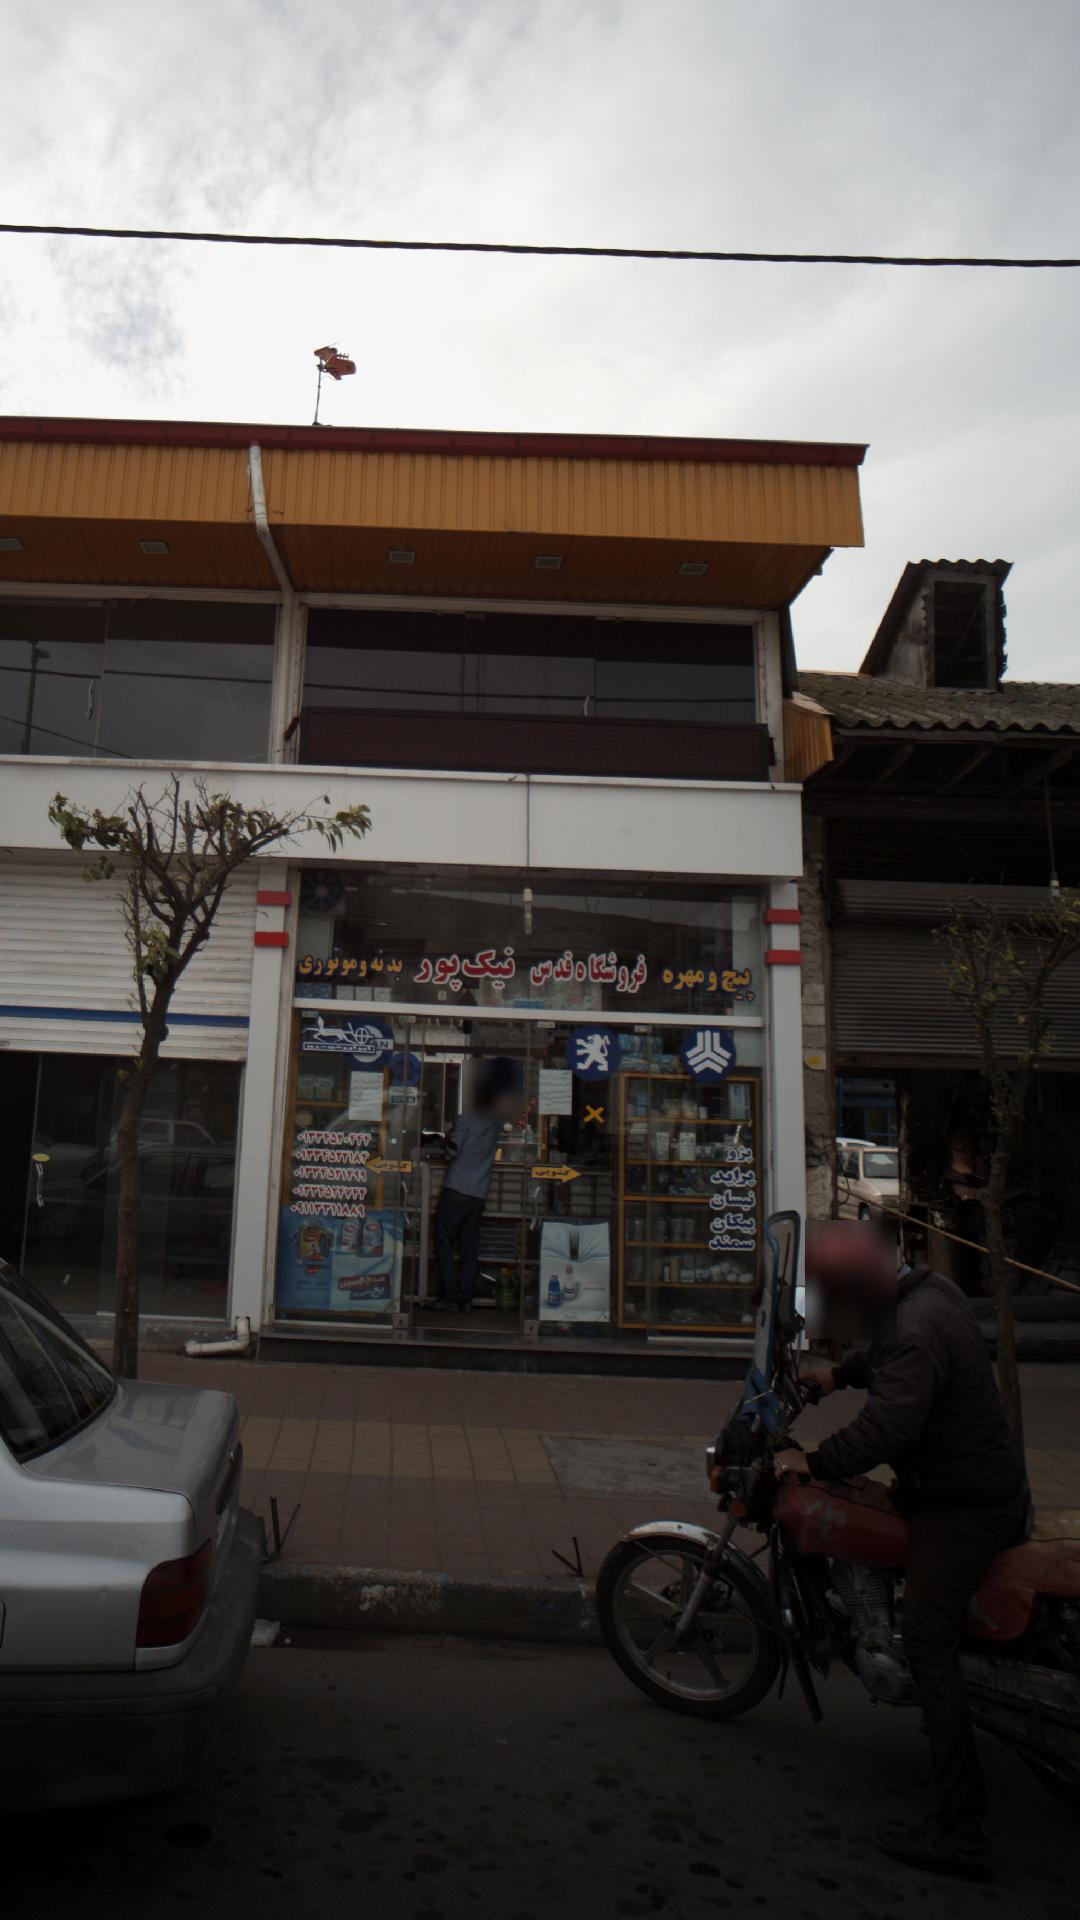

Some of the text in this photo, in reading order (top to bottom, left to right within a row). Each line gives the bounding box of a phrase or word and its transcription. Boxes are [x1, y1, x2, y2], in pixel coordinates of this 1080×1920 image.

[298, 947, 358, 977] موتوری
[371, 948, 403, 983] بدنه
[530, 950, 573, 986] قدس
[575, 950, 647, 994] فروشگاه
[662, 968, 756, 1001] پیچ و مهره
[727, 1144, 753, 1164] پژو
[710, 1166, 756, 1187] پراید
[709, 1189, 756, 1211] نیسان
[710, 1212, 756, 1235] پیکان
[709, 1235, 756, 1251] سمند
